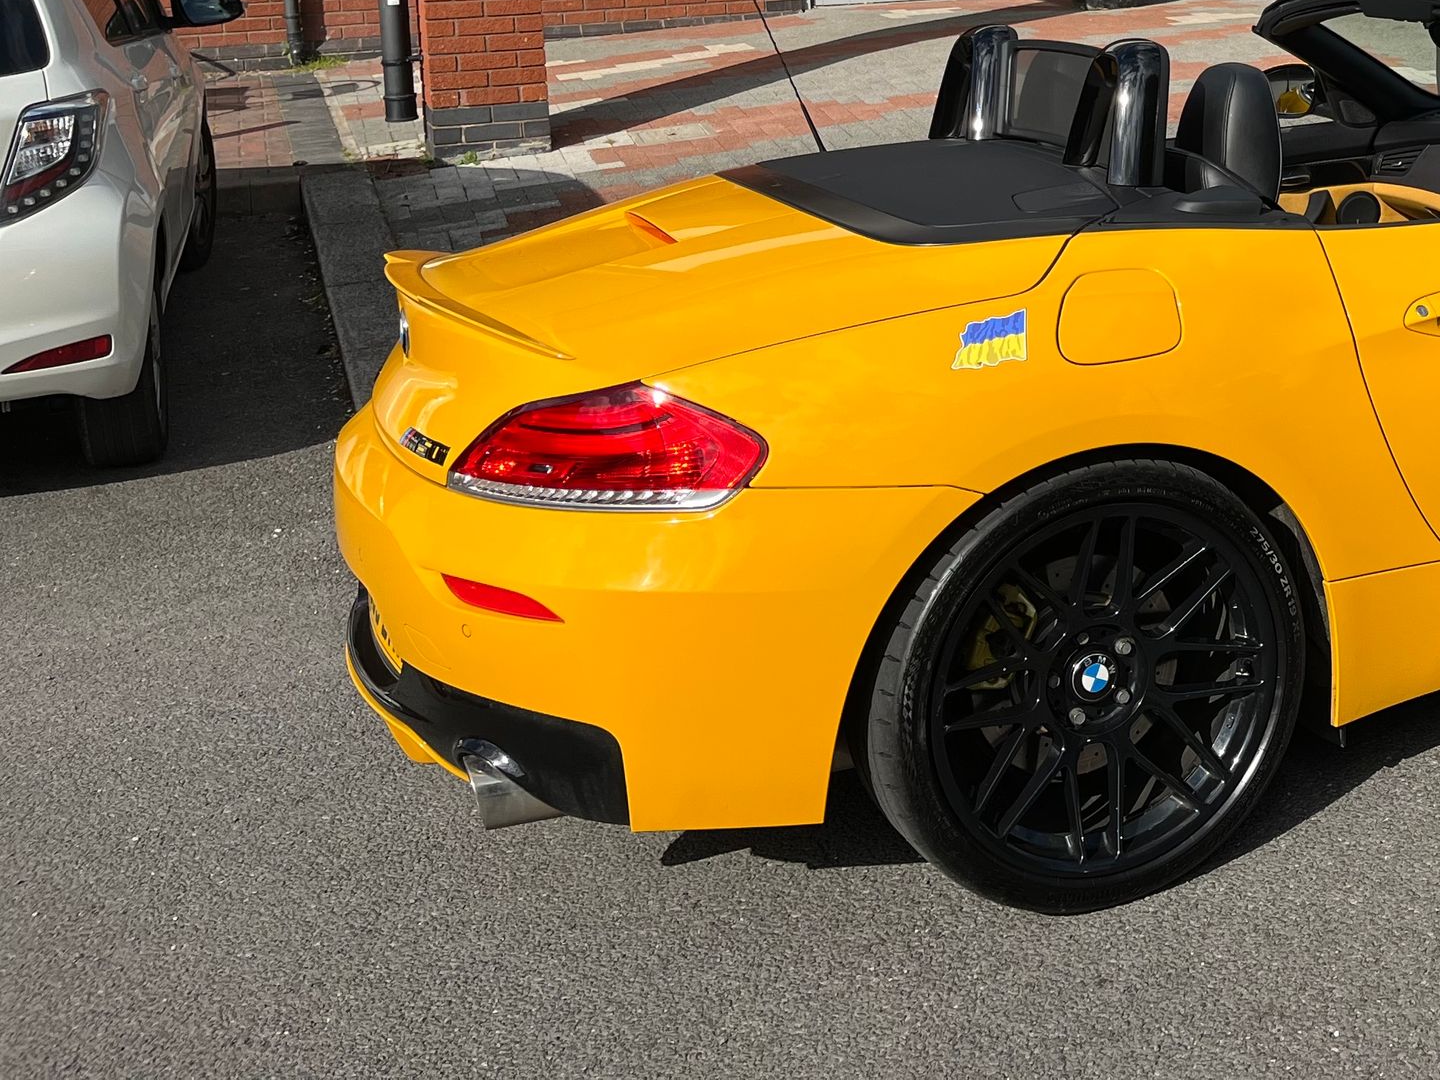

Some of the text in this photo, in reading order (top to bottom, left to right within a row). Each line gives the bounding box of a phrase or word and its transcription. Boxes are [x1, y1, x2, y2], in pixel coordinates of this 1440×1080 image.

[1250, 526, 1282, 574] 275/30
[1280, 576, 1292, 598] ZR
[1083, 655, 1116, 674] BMW
